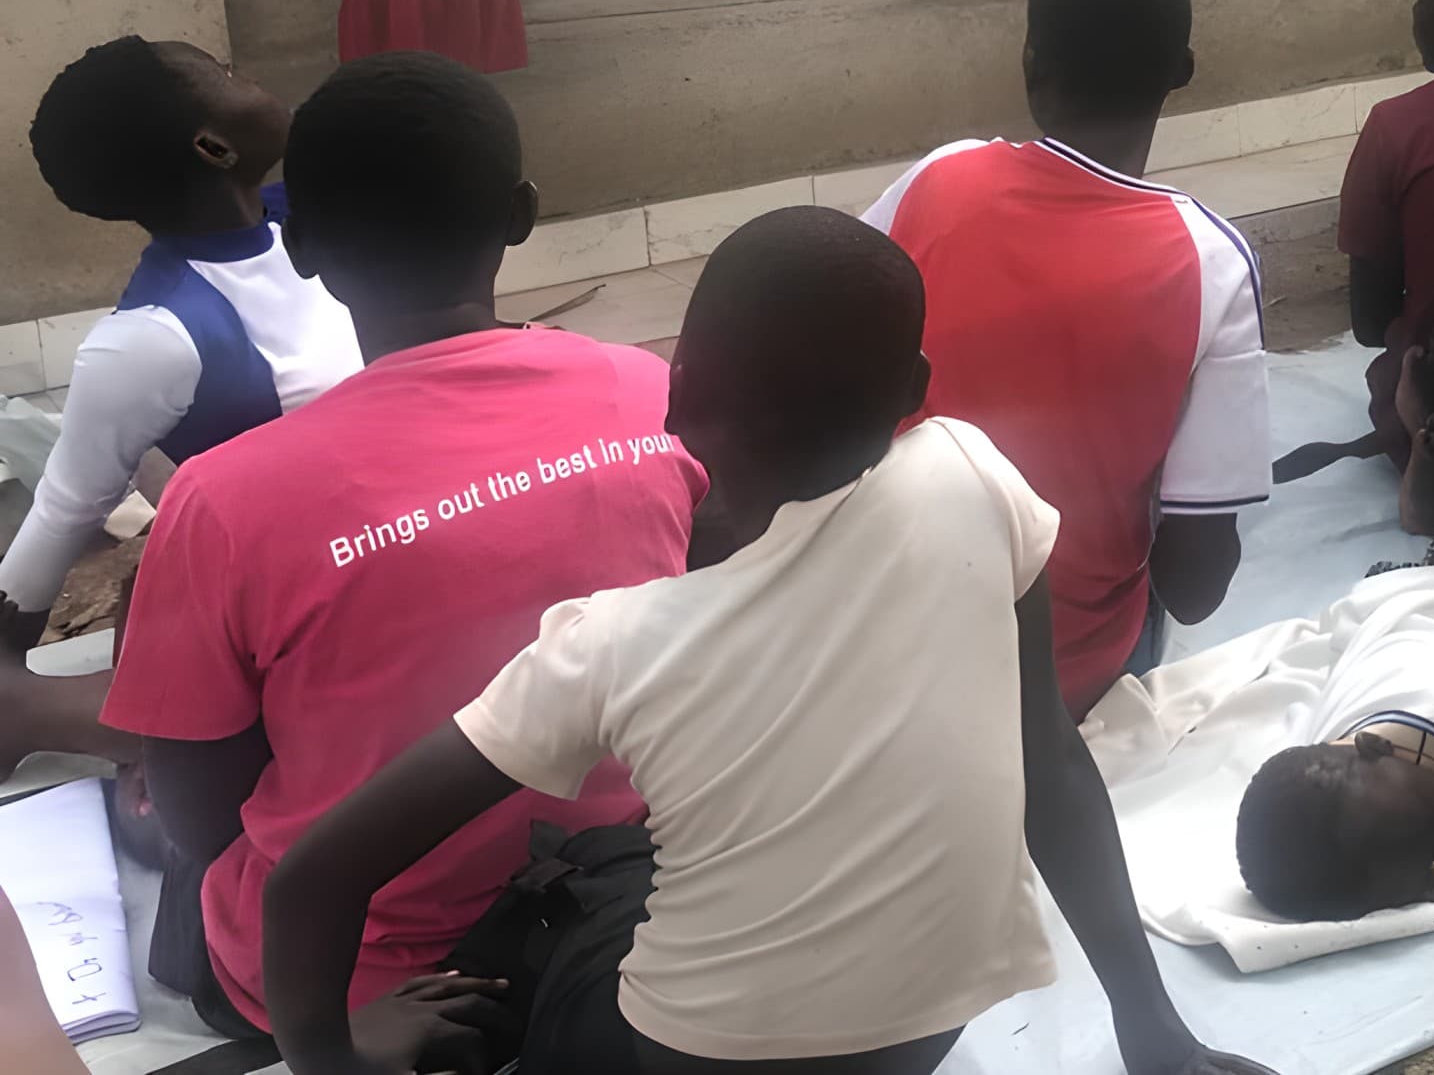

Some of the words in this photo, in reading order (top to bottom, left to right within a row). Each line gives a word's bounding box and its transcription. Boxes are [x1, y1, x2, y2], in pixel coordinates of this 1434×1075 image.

[329, 508, 430, 568] Brings
[437, 482, 485, 520] out
[487, 471, 531, 502] the
[536, 444, 598, 484] best
[597, 438, 624, 465] in
